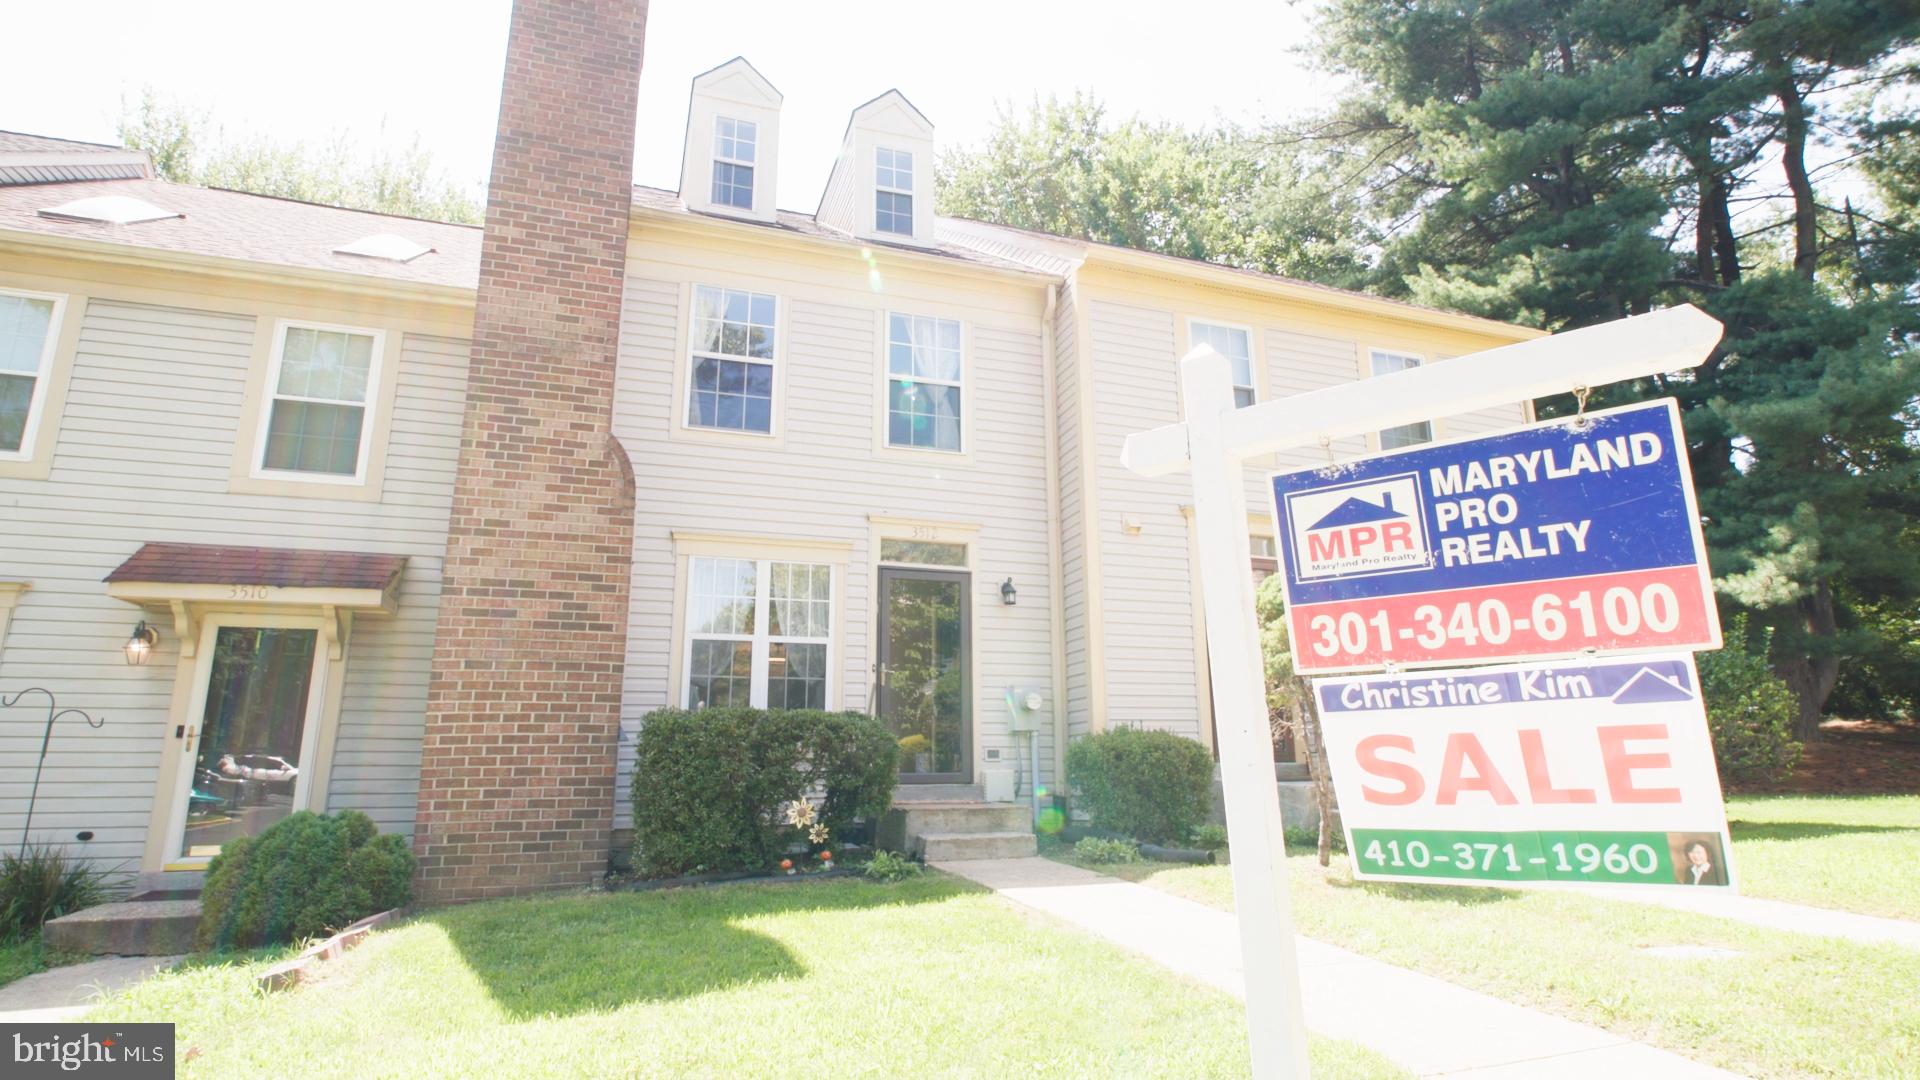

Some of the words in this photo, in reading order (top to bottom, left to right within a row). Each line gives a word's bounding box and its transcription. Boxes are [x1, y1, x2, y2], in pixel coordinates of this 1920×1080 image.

[1430, 432, 1663, 497] MARYLAND
[1435, 493, 1518, 532] PRO
[911, 526, 938, 540] 3512
[1307, 521, 1415, 562] MPR
[1440, 520, 1592, 568] REALTY
[1383, 554, 1416, 563] Realty
[228, 585, 269, 600] 3510
[1311, 582, 1680, 658] 301-340-6100
[1341, 676, 1502, 710] Christine
[1518, 670, 1593, 701] Kim
[1354, 723, 1682, 807] SALE
[1364, 839, 1658, 874] 410-371-1960
